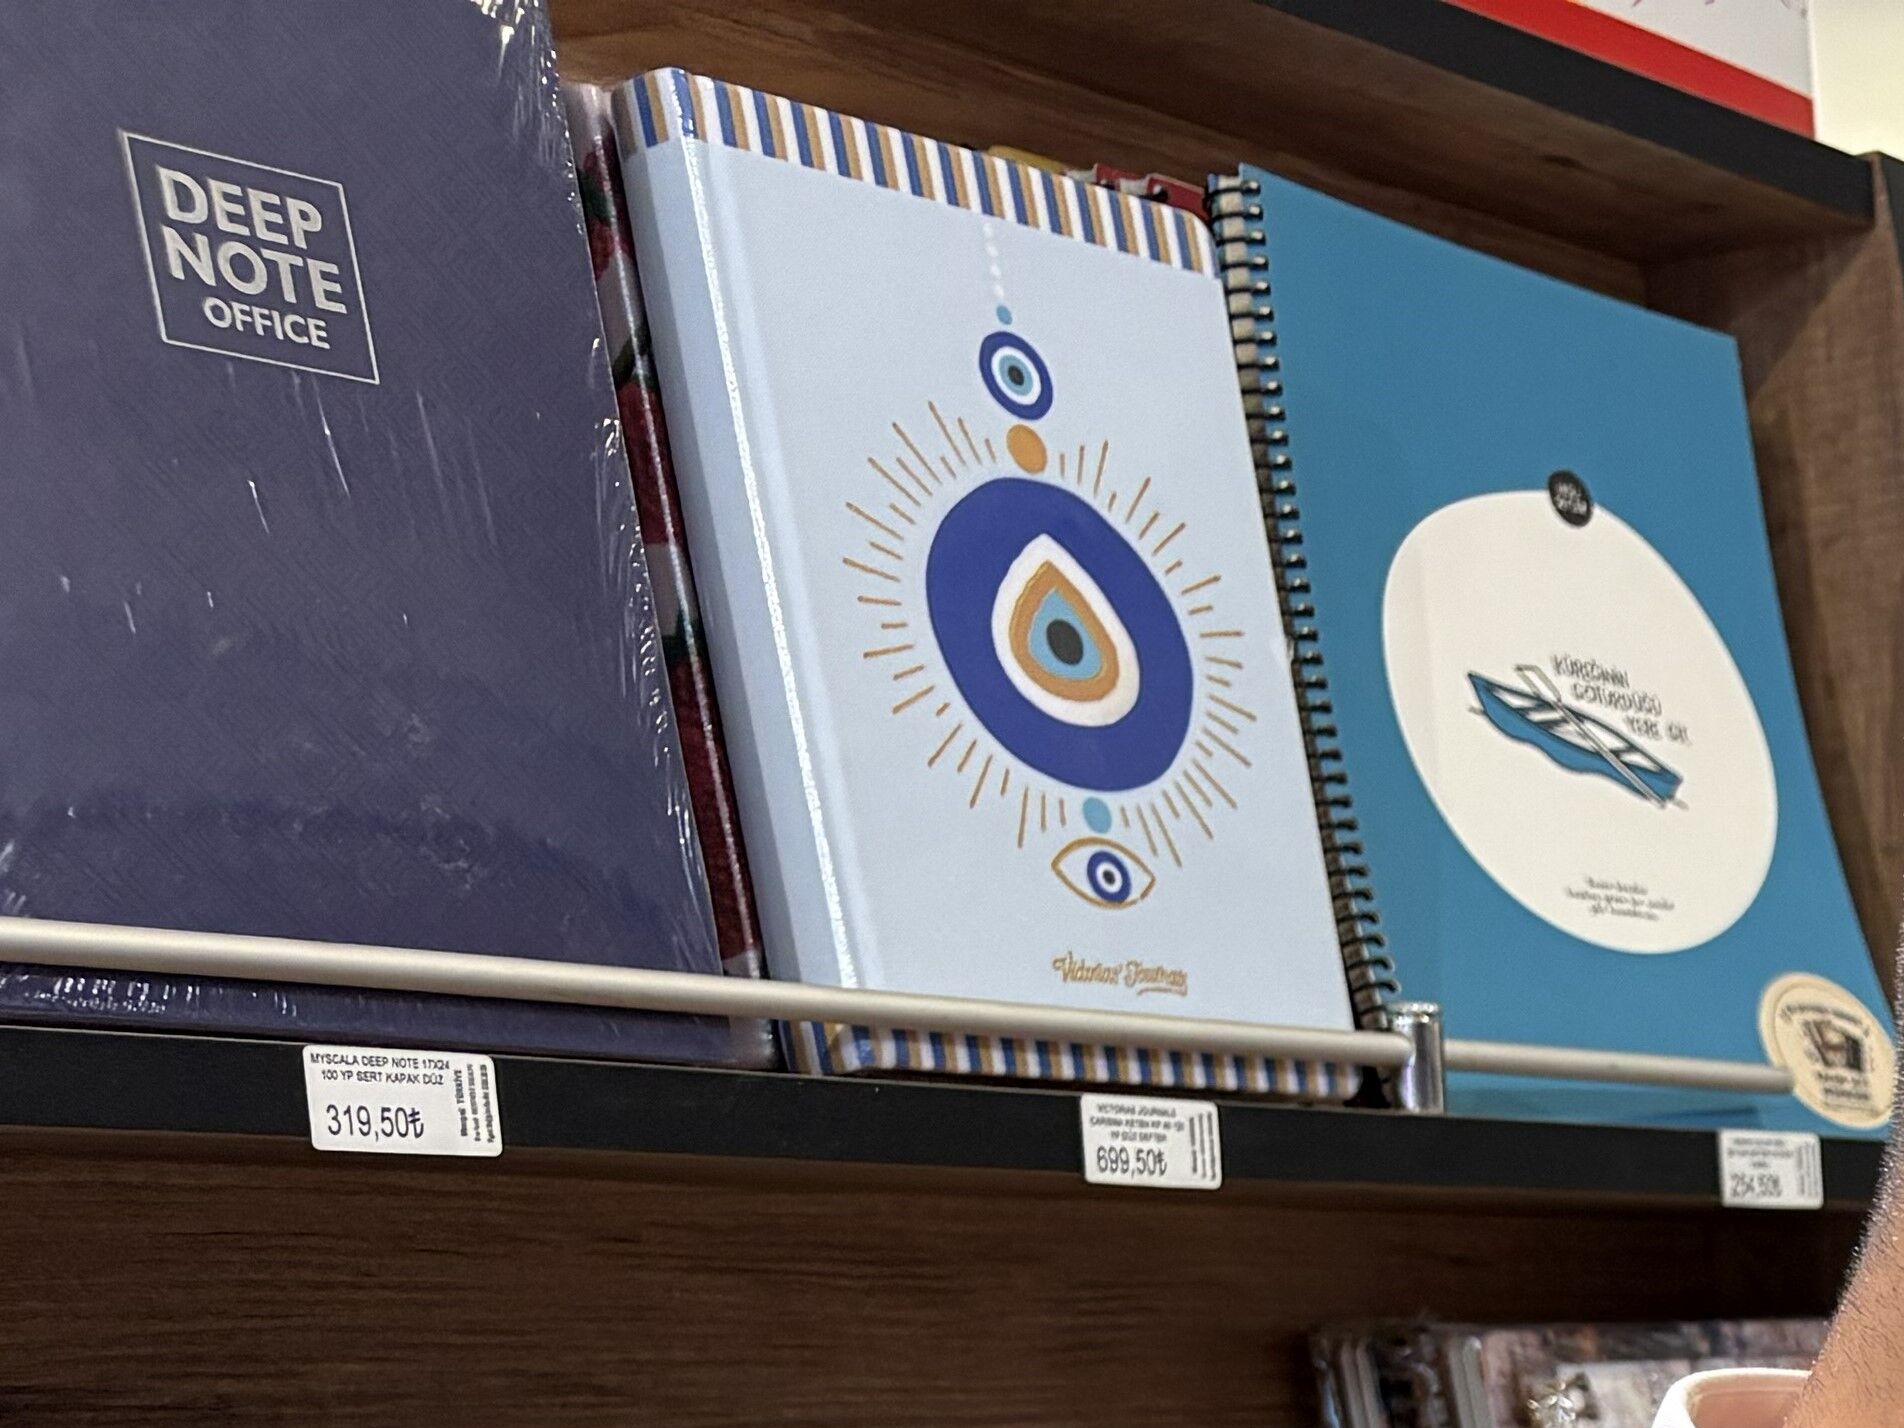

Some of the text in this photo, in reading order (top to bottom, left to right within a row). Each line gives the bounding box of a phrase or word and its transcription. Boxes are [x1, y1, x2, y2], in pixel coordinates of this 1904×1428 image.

[157, 164, 322, 249] DEEP
[161, 224, 347, 314] NOTE
[203, 297, 330, 349] OFFICE
[321, 1069, 338, 1080] 100
[341, 1070, 354, 1081] YP
[356, 1071, 383, 1082] SERT
[385, 1072, 421, 1084] KAPAK
[361, 1055, 389, 1068] DEEP
[391, 1056, 419, 1069] NOTE
[325, 1104, 425, 1142] 319,50₺
